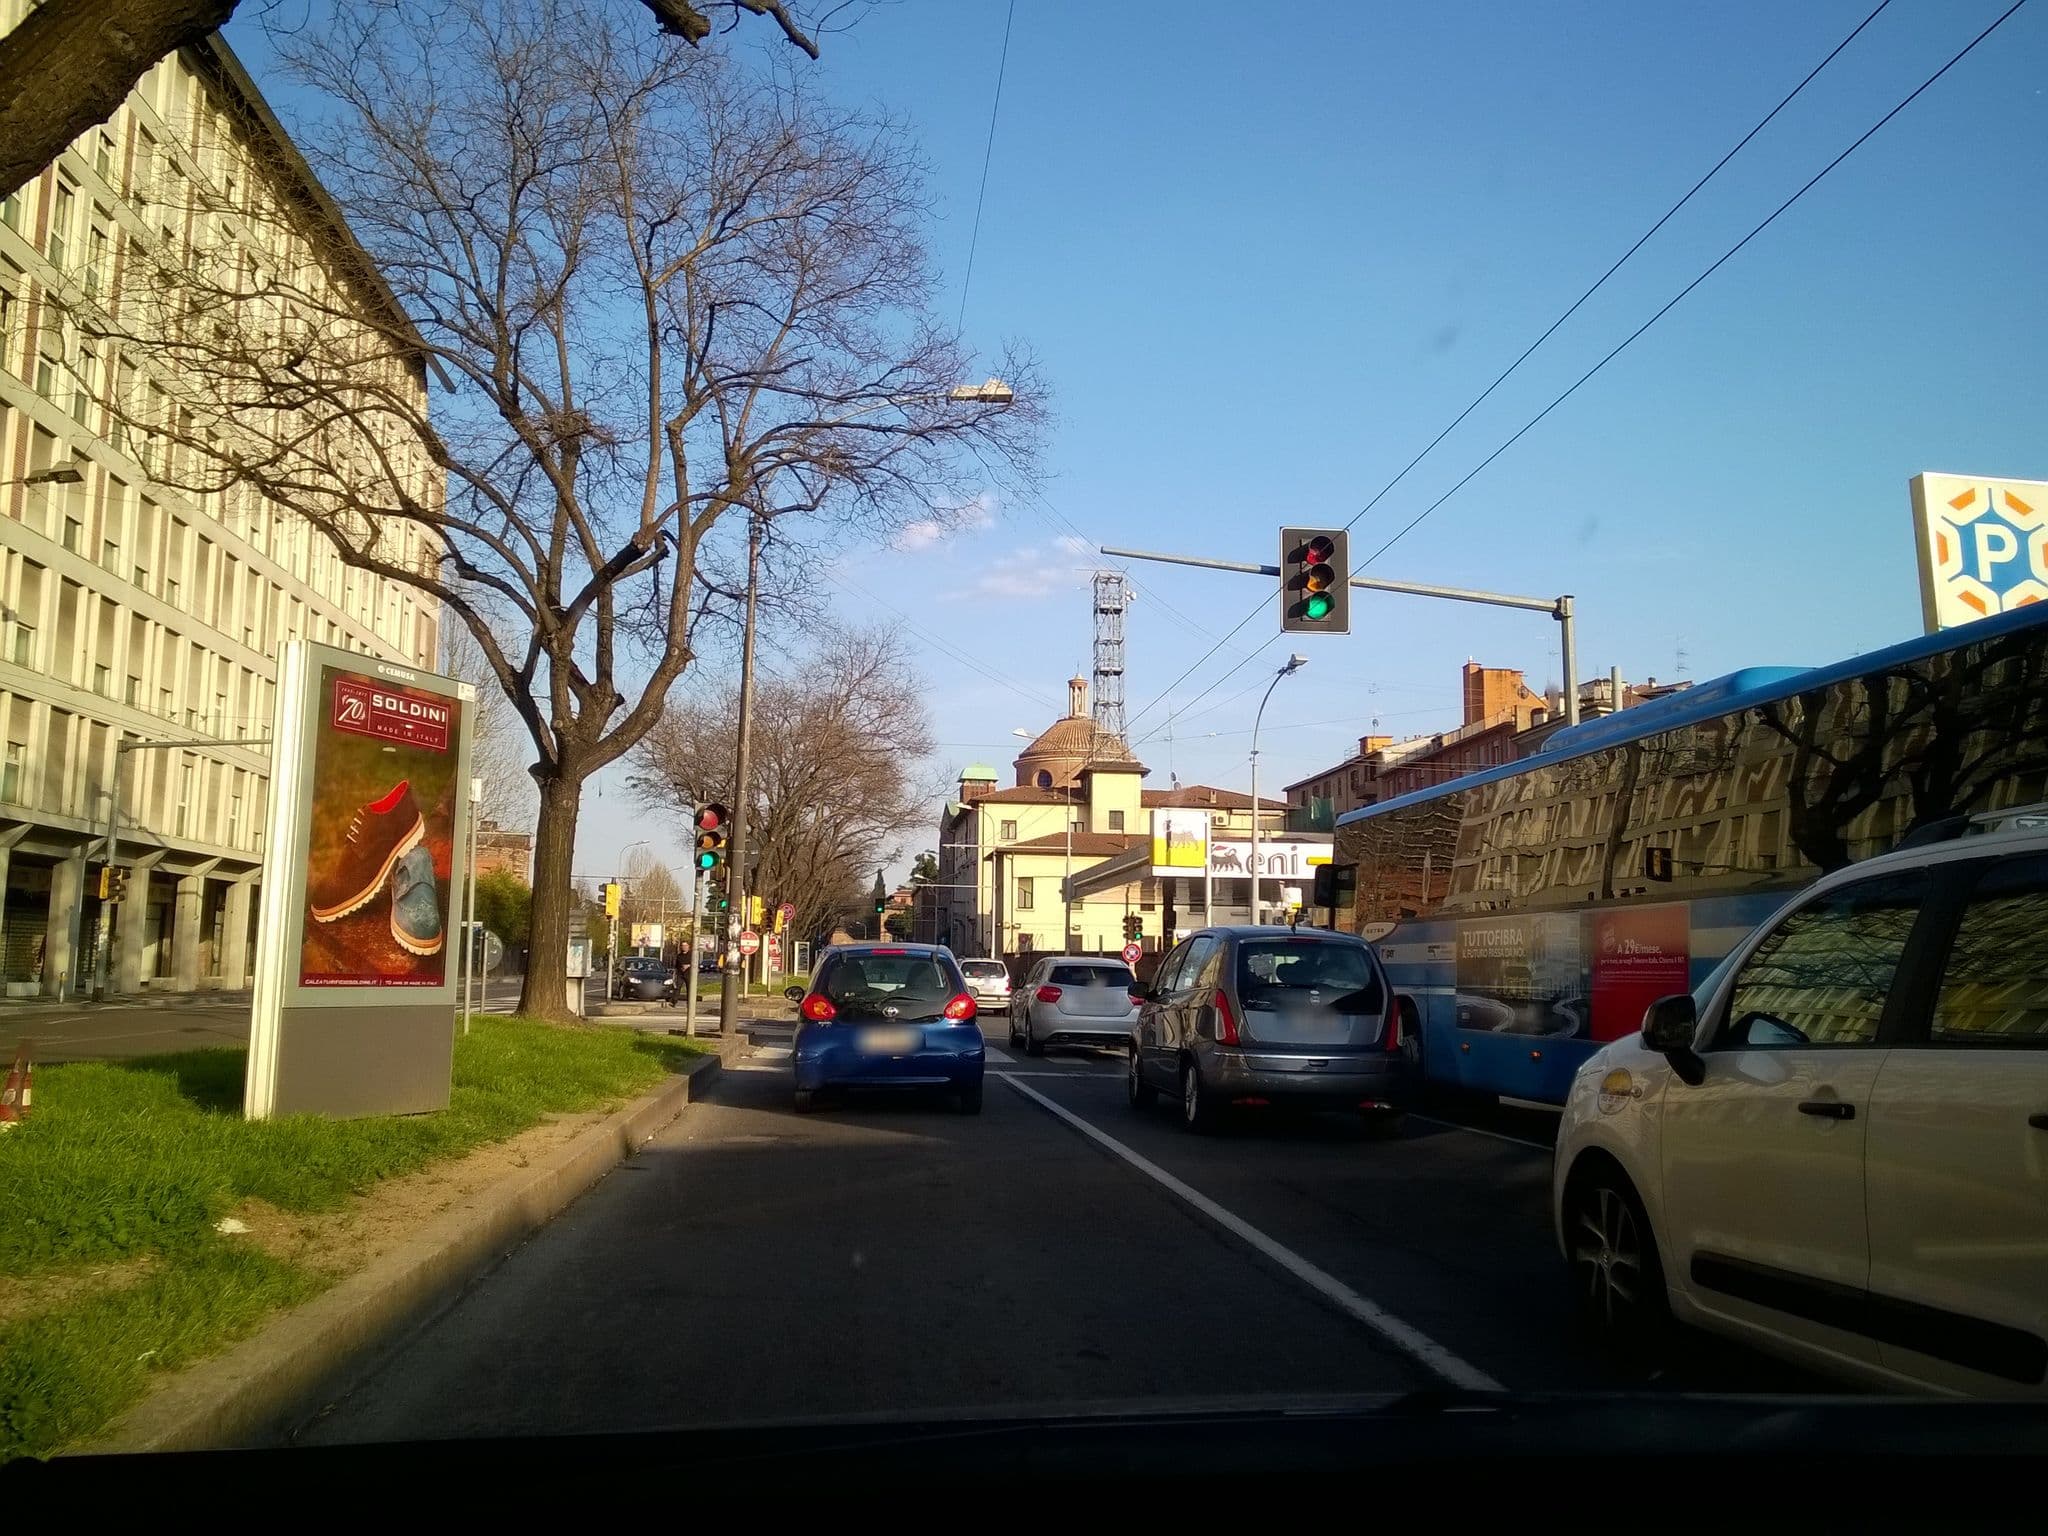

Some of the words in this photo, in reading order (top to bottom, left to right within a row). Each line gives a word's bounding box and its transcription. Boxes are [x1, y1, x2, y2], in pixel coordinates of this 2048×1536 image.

[1974, 522, 2018, 583] P
[385, 667, 416, 681] CEMUSA
[372, 694, 446, 723] SOLDINI
[377, 724, 399, 735] MADE
[416, 733, 439, 744] ITALY
[1245, 845, 1298, 875] eni
[1463, 928, 1524, 947] TUTTOFIBRA
